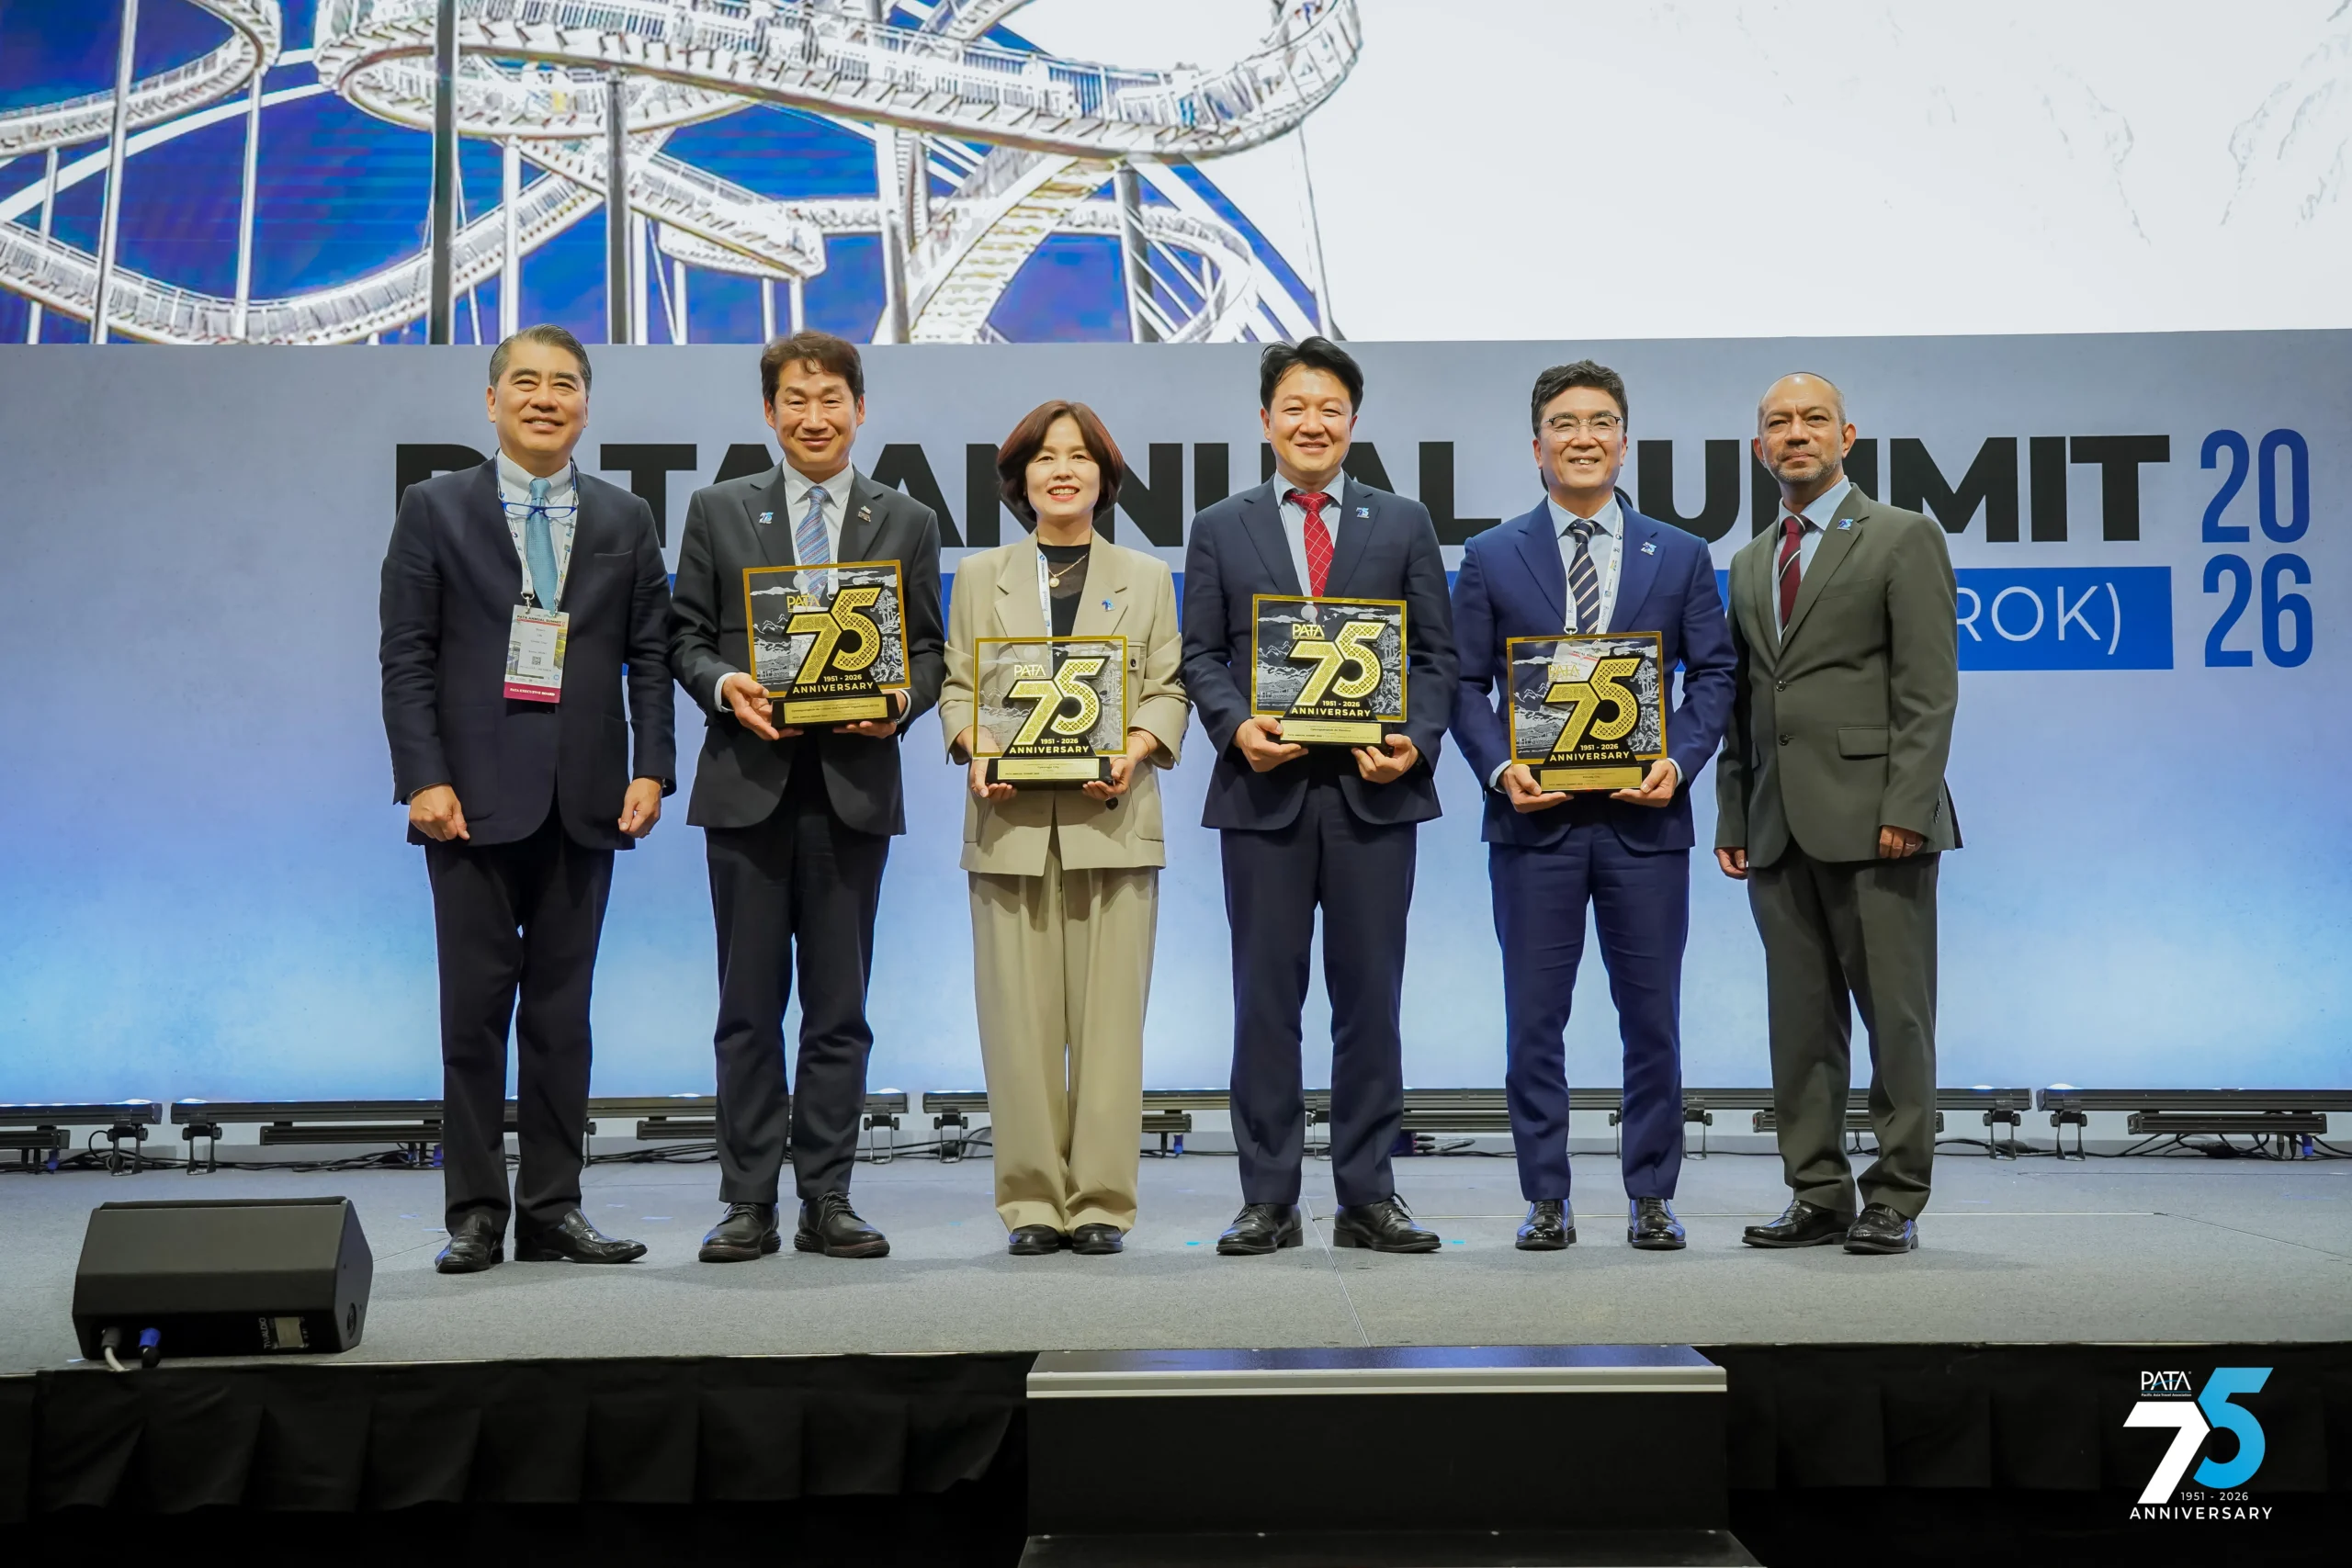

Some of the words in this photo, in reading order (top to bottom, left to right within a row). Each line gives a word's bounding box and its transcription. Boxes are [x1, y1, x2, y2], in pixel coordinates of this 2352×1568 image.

[2200, 428, 2311, 544] 20
[786, 594, 820, 609] PATA
[2202, 552, 2313, 669] 26
[786, 587, 882, 685] 75
[1292, 624, 1325, 637] PATA
[1013, 664, 1046, 677] PATA
[1289, 621, 1386, 706] 75
[792, 682, 874, 694] ANNIVERSARY
[1009, 658, 1105, 745] 75
[1545, 658, 1642, 753] 75
[1291, 707, 1371, 716] ANNIVERSARY
[1009, 745, 1090, 754] ANNIVERSARY
[1549, 750, 1630, 761] ANNIVERSARY
